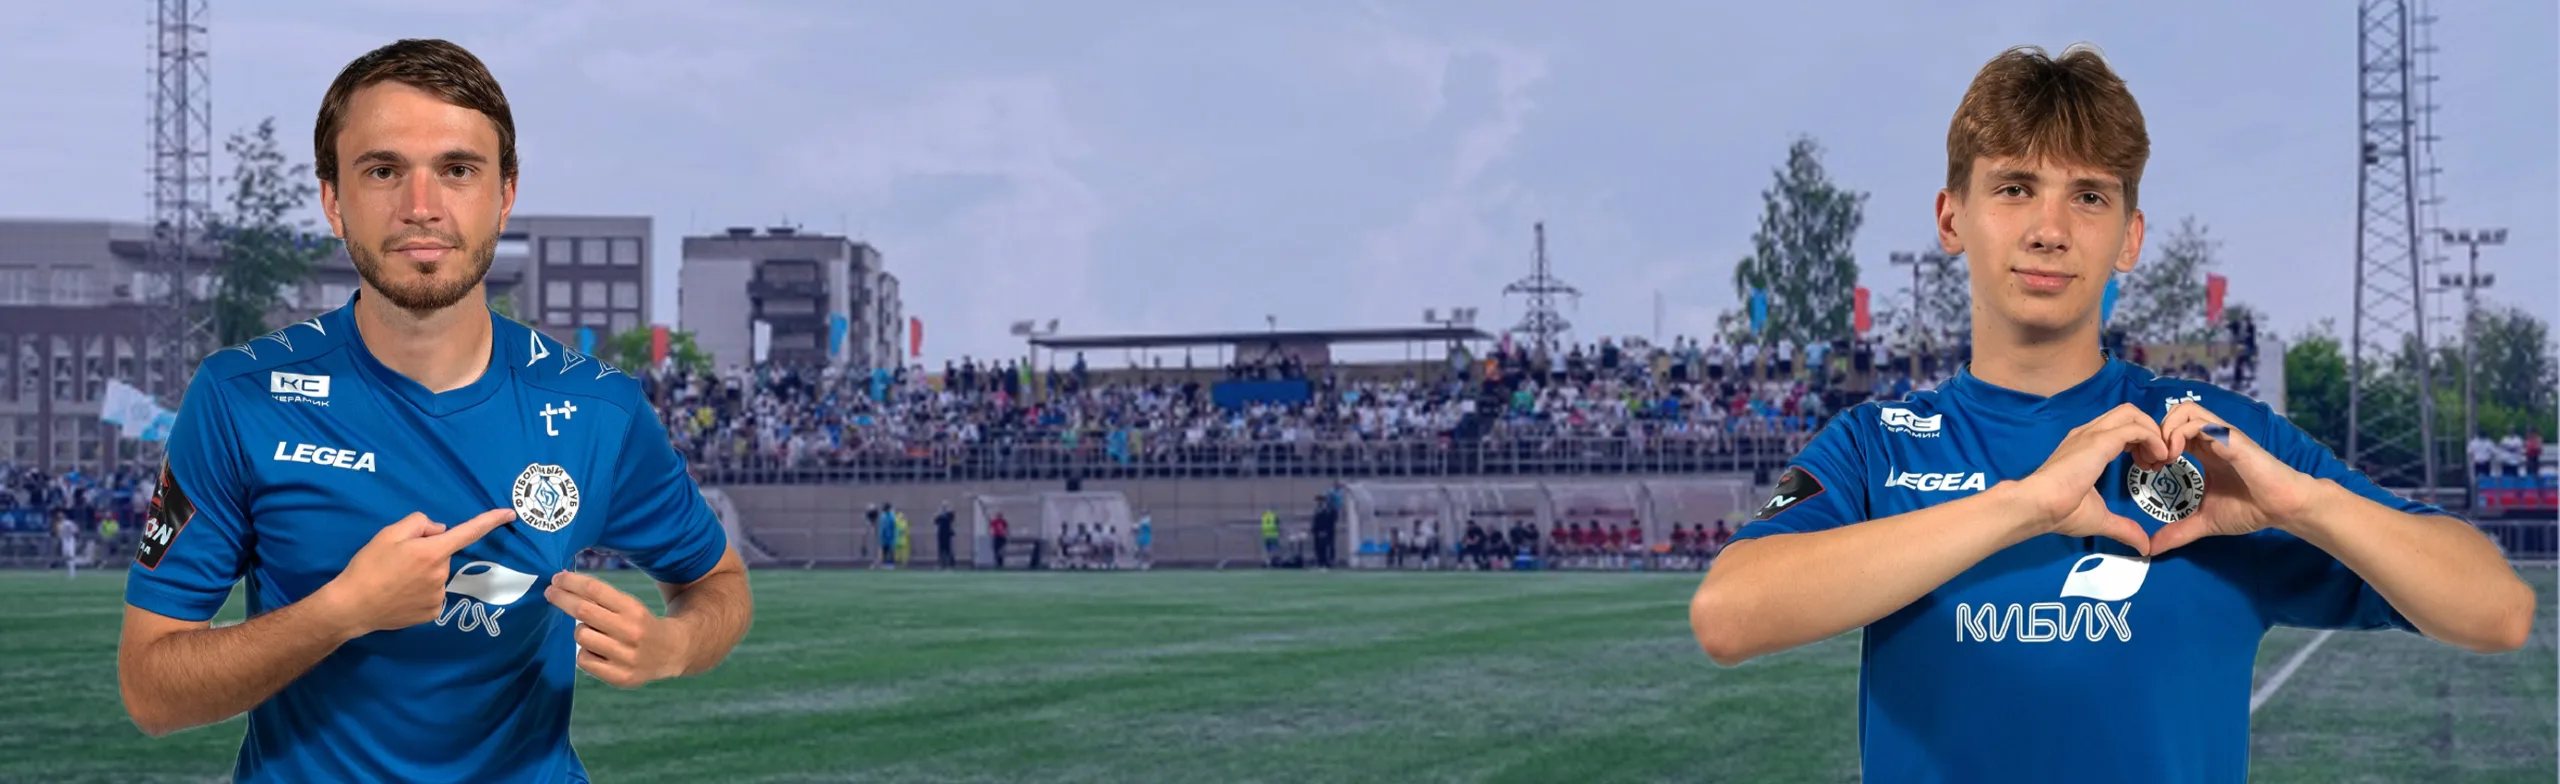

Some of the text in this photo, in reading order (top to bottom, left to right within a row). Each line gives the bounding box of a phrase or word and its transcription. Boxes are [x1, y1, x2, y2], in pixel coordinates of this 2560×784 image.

[273, 441, 376, 472] LEGEA
[514, 464, 578, 507] ФУТБОЛНЫЙ КЛУБ
[1885, 466, 1986, 491] LEGEA
[1956, 602, 2132, 642] КИБИХ
